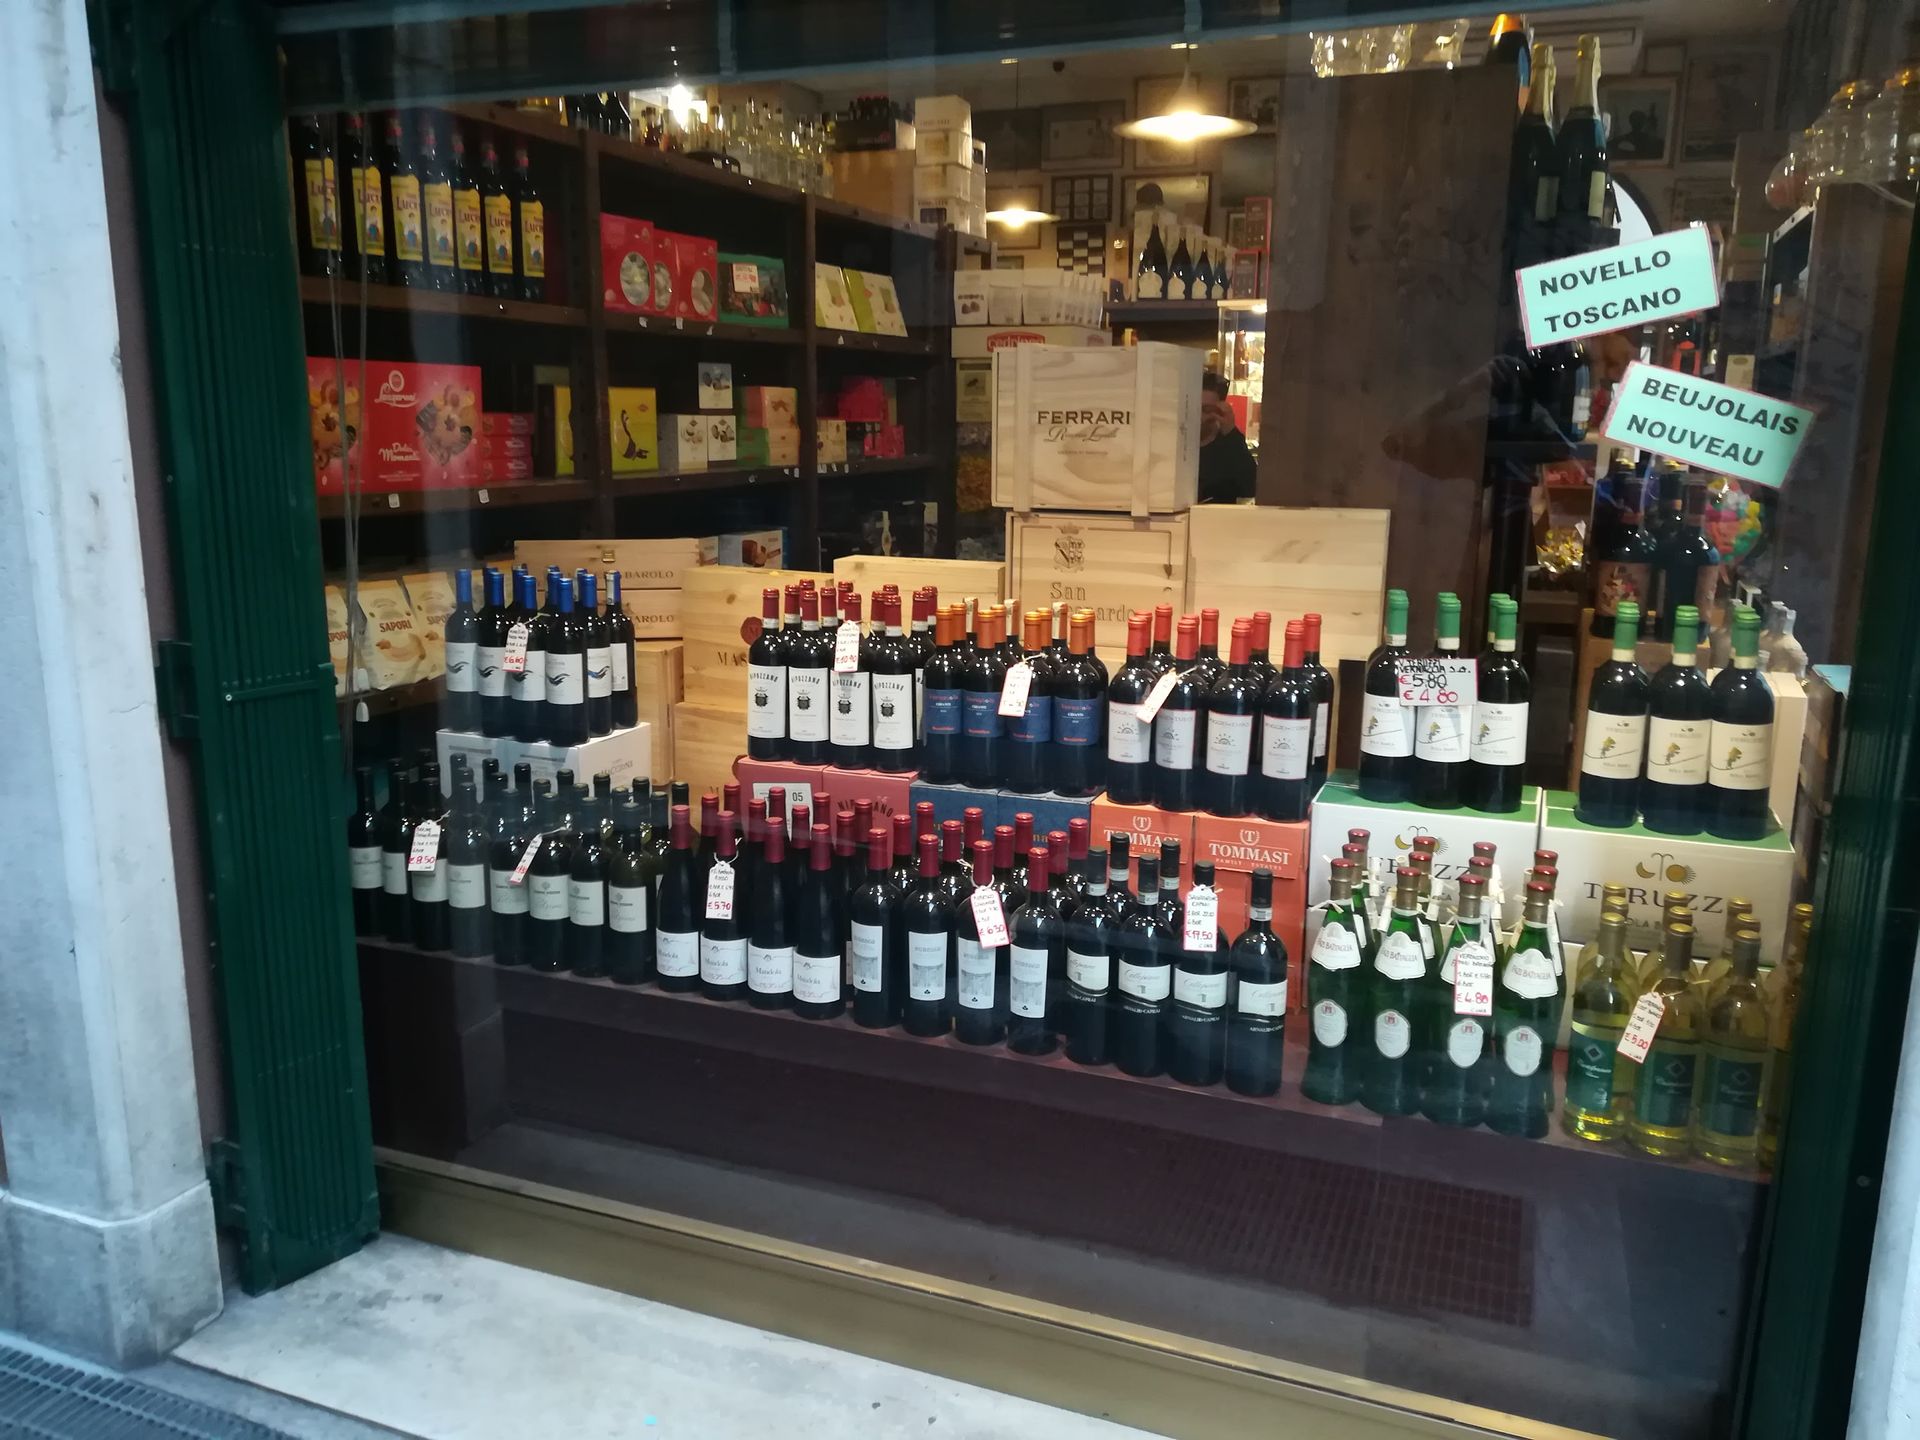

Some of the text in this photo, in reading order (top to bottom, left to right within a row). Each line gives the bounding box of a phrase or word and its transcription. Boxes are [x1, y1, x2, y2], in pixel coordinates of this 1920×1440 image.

[1539, 250, 1672, 297] NOVELLO
[1544, 287, 1682, 333] TOSCANO
[1641, 378, 1800, 436] BEUJOLAIS
[1037, 410, 1131, 425] FERRARI
[1626, 414, 1765, 467] NOUVEAU
[625, 570, 674, 579] BAROLO
[1050, 581, 1087, 601] San
[379, 619, 413, 633] SAPORI
[633, 614, 675, 623] AROLO
[717, 651, 748, 667] MAS
[792, 792, 804, 802] 05
[837, 799, 894, 817] NIPANO
[1209, 842, 1290, 865] TOMMASI
